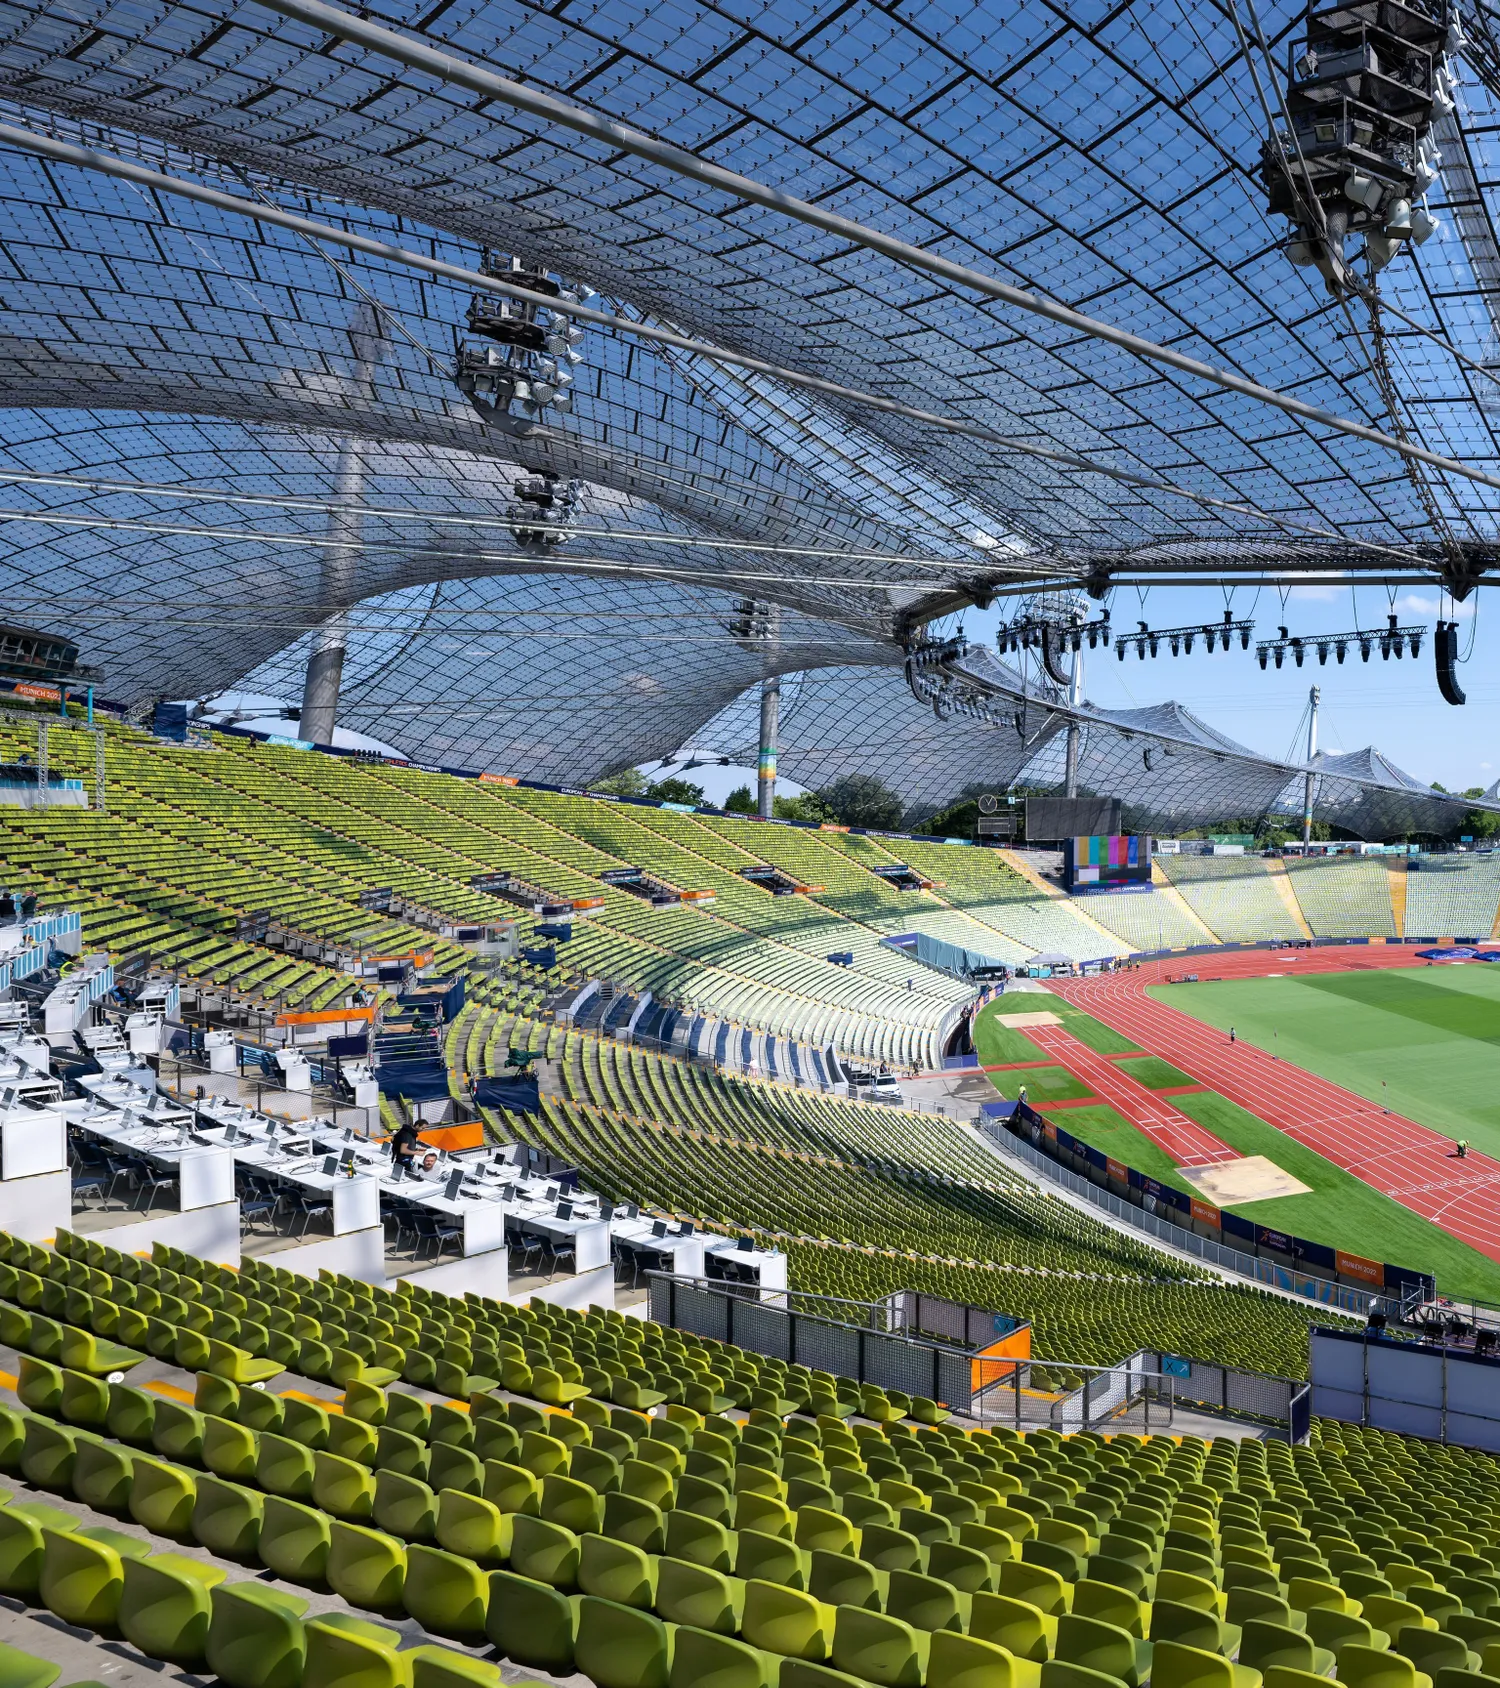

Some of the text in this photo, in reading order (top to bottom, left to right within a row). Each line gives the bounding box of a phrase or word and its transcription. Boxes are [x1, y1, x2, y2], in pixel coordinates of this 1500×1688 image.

[20, 687, 46, 698] MUNICH
[1341, 1259, 1377, 1276] MUNICH 2022
